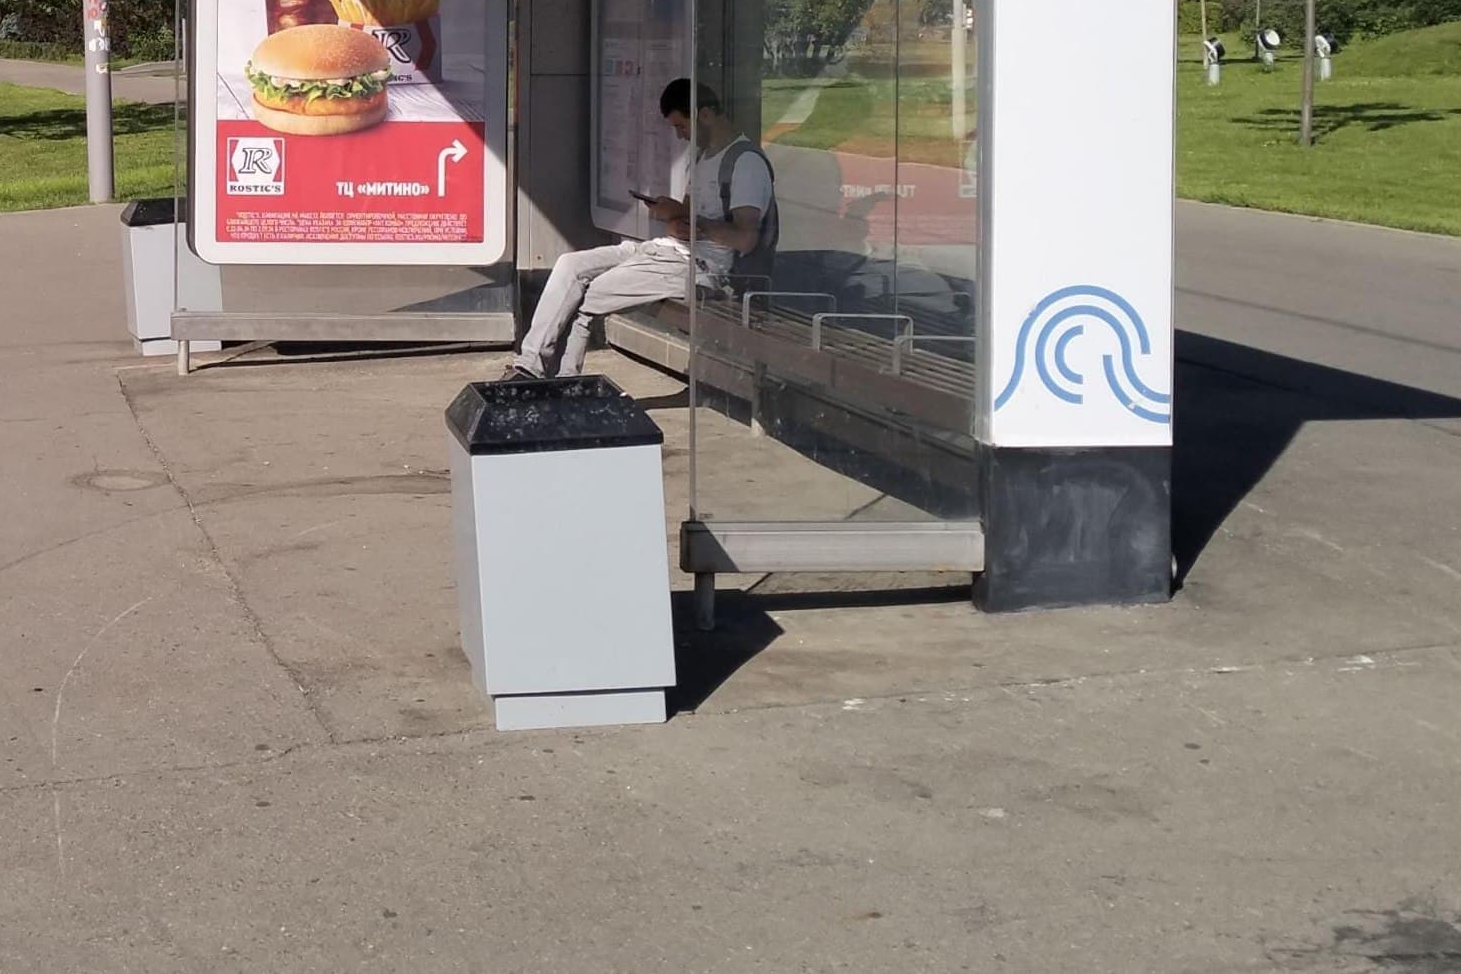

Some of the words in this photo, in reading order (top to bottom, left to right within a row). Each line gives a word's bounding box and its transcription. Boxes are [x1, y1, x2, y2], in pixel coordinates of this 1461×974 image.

[230, 185, 281, 193] ROSTIC'S
[336, 182, 355, 198] ТЦ
[357, 182, 430, 196] «МИТИНО»
